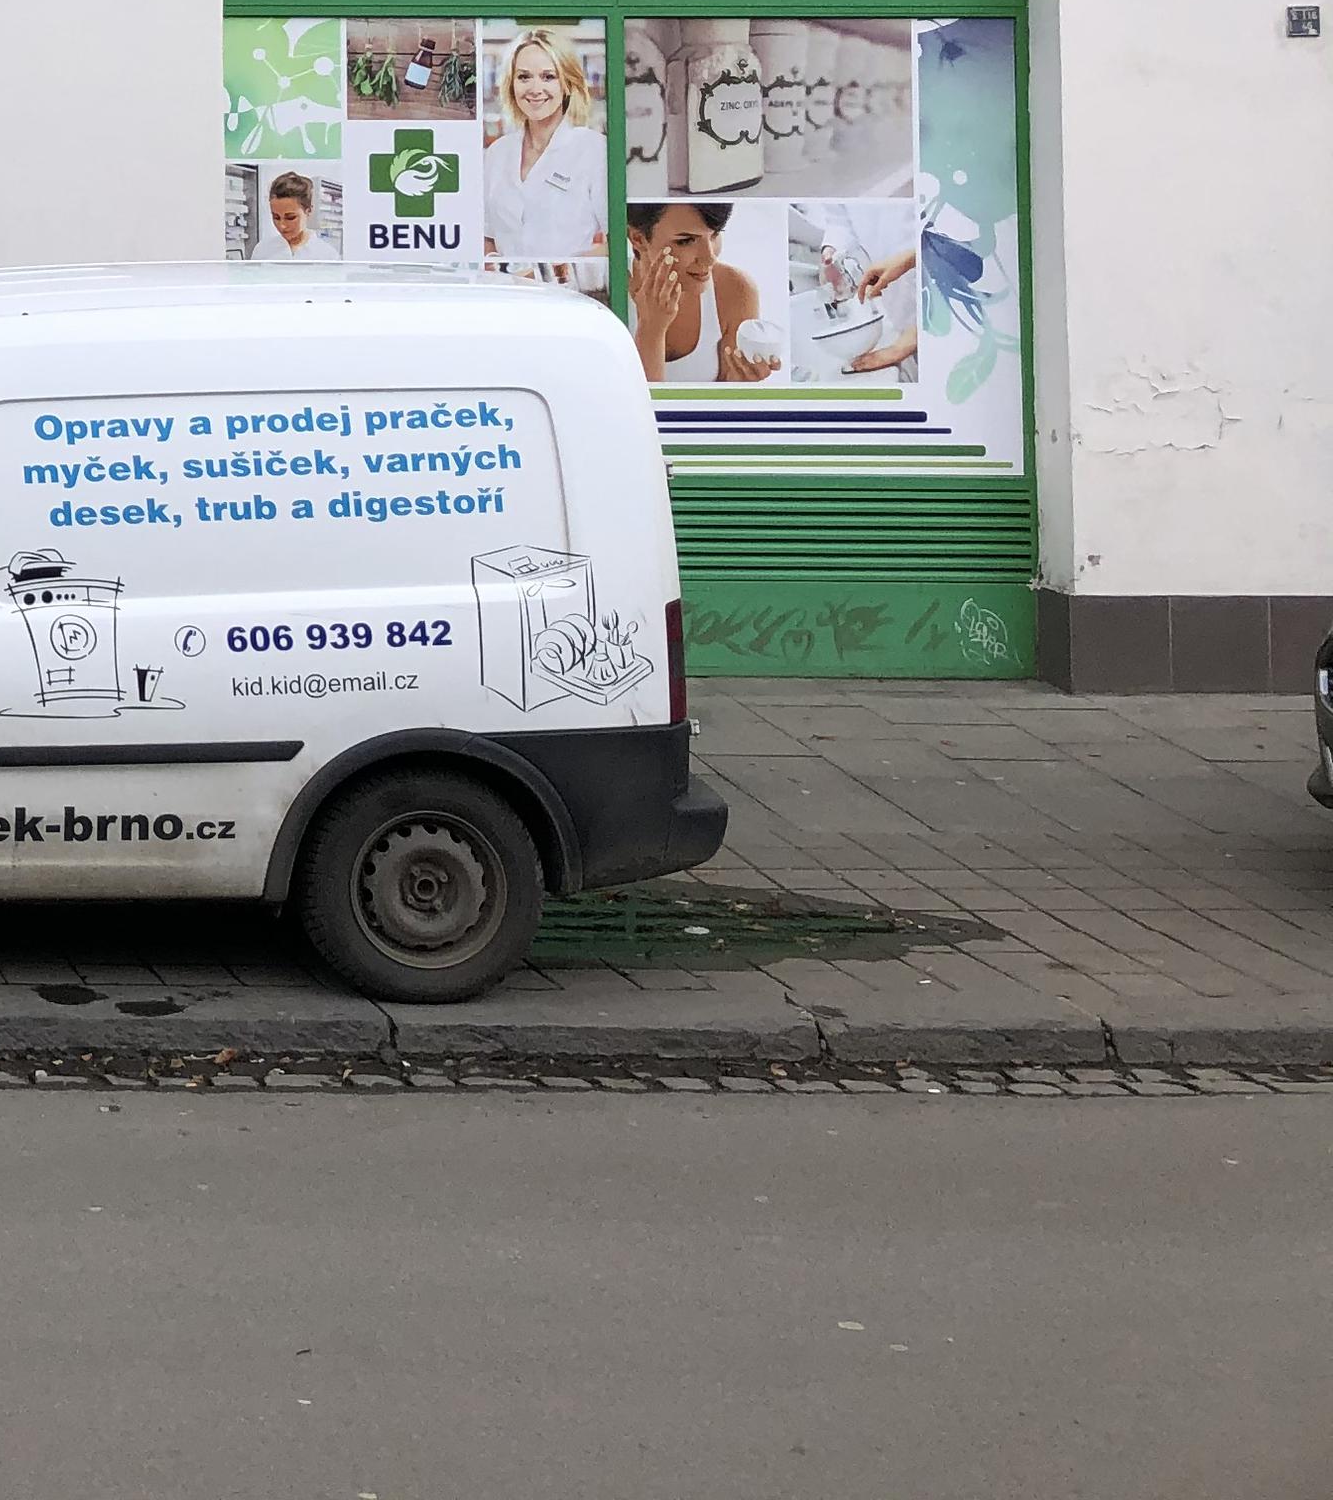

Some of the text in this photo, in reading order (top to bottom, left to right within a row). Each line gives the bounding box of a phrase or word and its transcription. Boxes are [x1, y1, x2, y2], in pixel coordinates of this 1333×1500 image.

[369, 224, 461, 250] BENU
[34, 401, 514, 445] Opravy a prodej praček,
[23, 445, 522, 488] myček, sušiček, varných
[49, 487, 505, 529] desek, trub a digestoří
[226, 620, 454, 653] 606 939 842
[231, 671, 420, 700] kid.kid@email.cz
